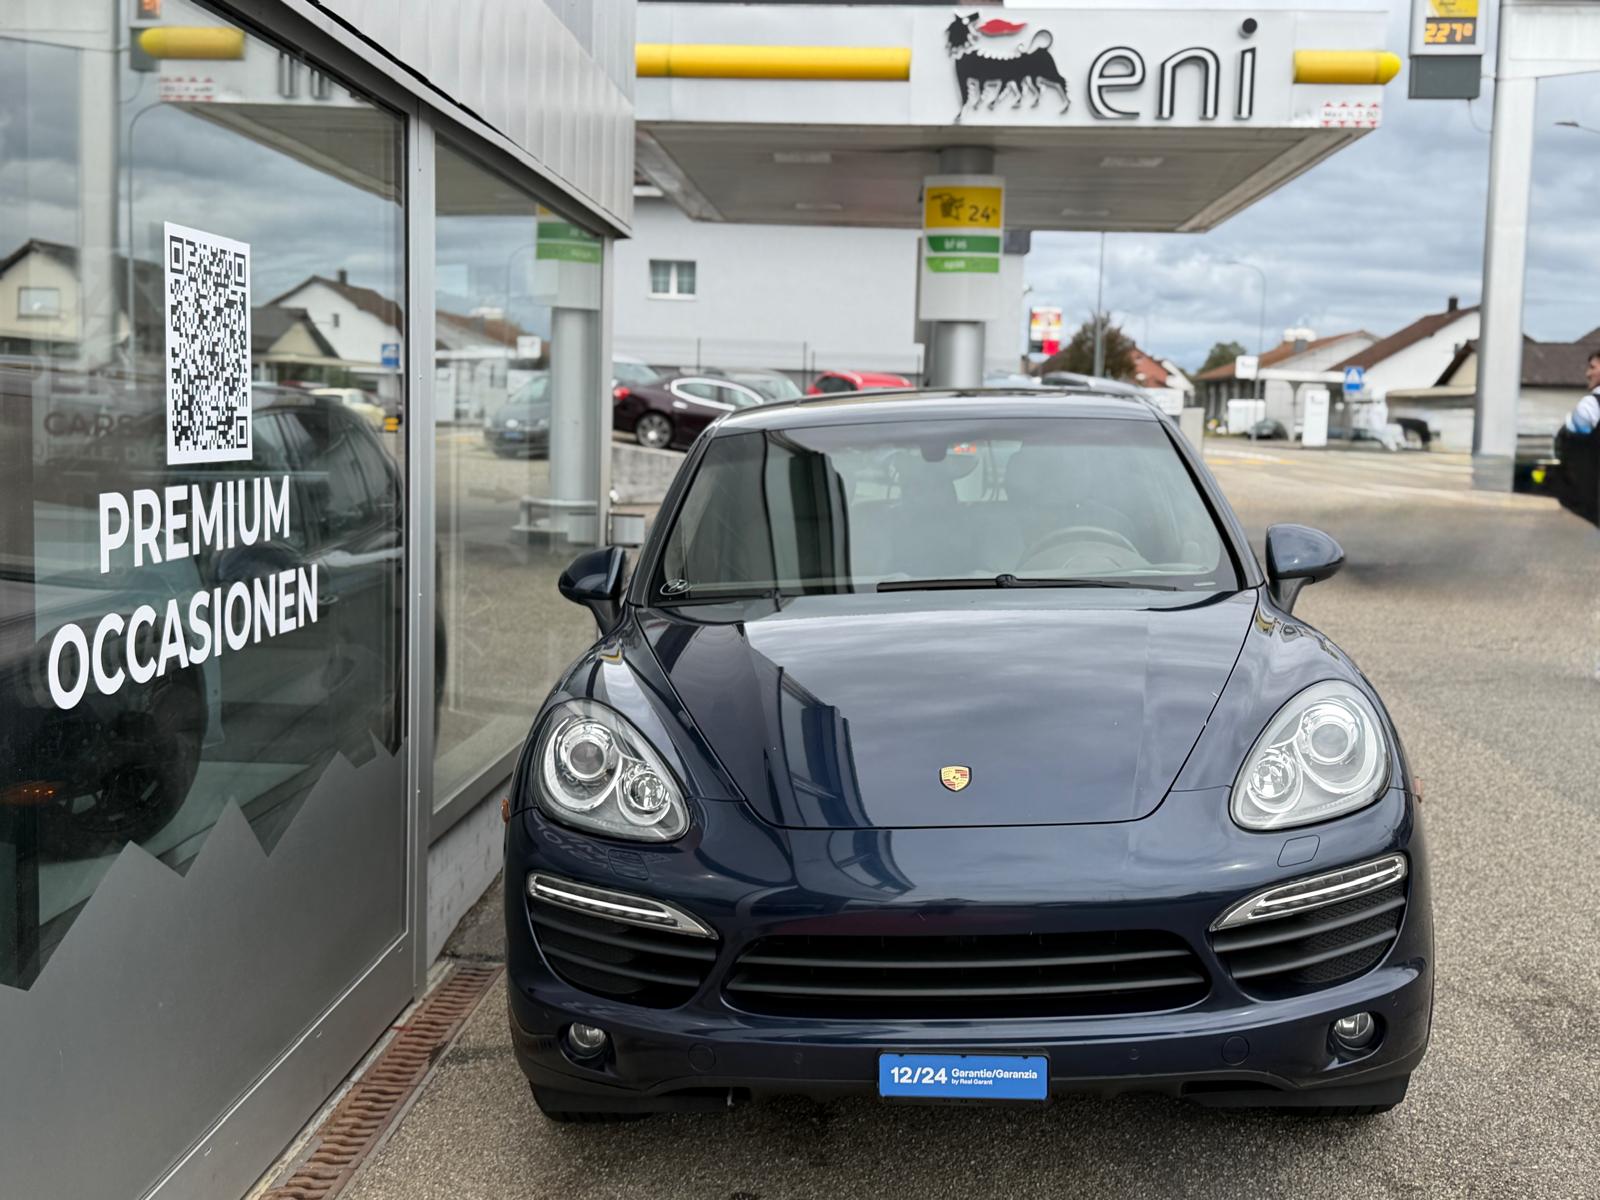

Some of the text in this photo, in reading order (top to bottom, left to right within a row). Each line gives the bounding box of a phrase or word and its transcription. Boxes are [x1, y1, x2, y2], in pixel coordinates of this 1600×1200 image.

[1087, 17, 1258, 121] eni
[99, 475, 290, 574] PREMIUM
[48, 564, 318, 710] OCCASIONEN
[890, 1066, 1038, 1084] 12/24 Garantie/Garanzia
